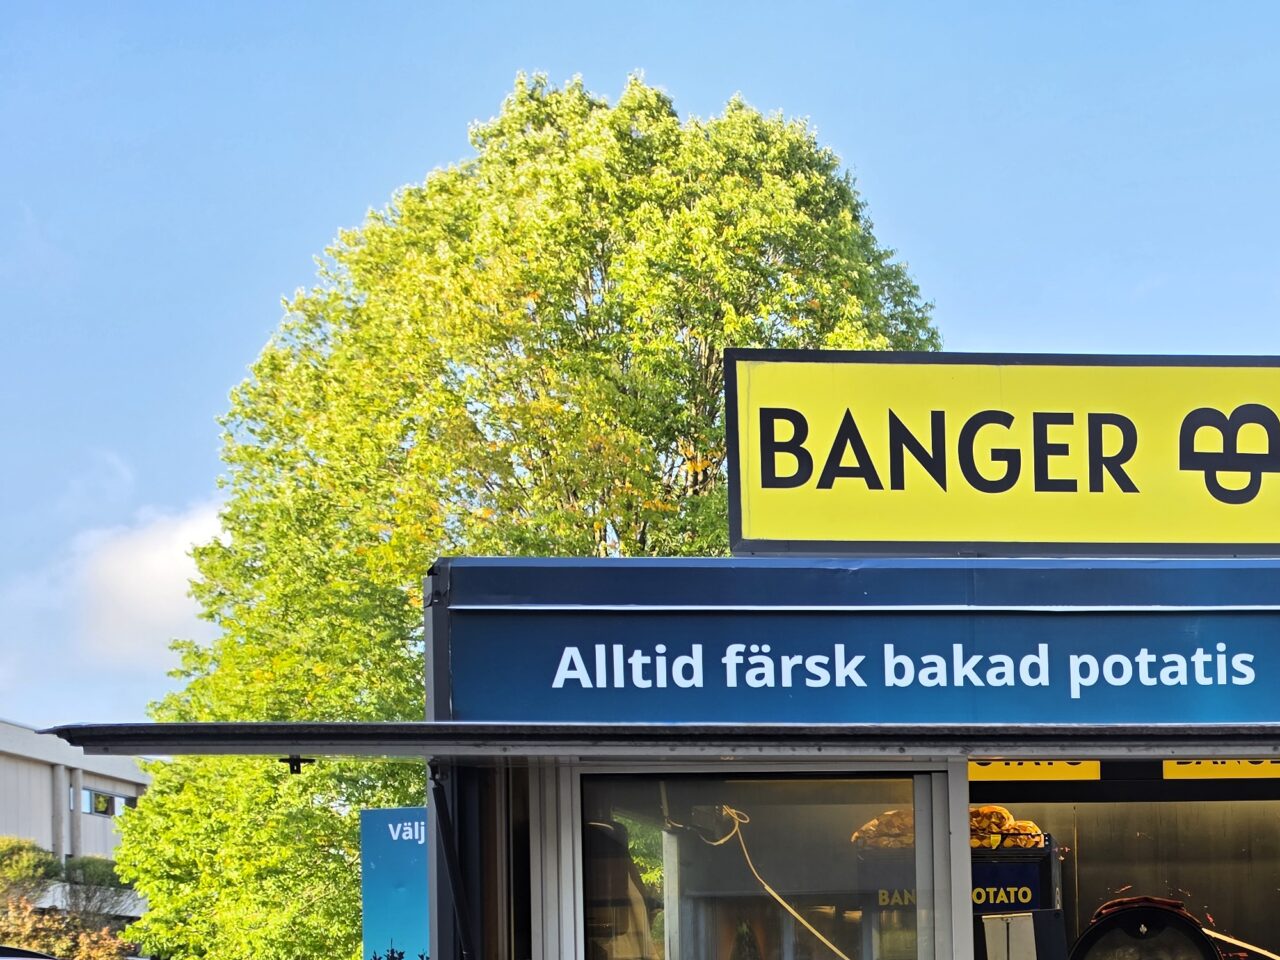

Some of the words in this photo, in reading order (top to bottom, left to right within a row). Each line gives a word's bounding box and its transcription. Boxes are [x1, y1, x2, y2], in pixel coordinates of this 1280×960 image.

[759, 406, 1140, 493] BANGER
[552, 644, 704, 689] Alltid
[723, 643, 867, 688] färsk
[884, 643, 1050, 686] bakad
[1071, 642, 1256, 699] potatis
[388, 821, 425, 844] Välj
